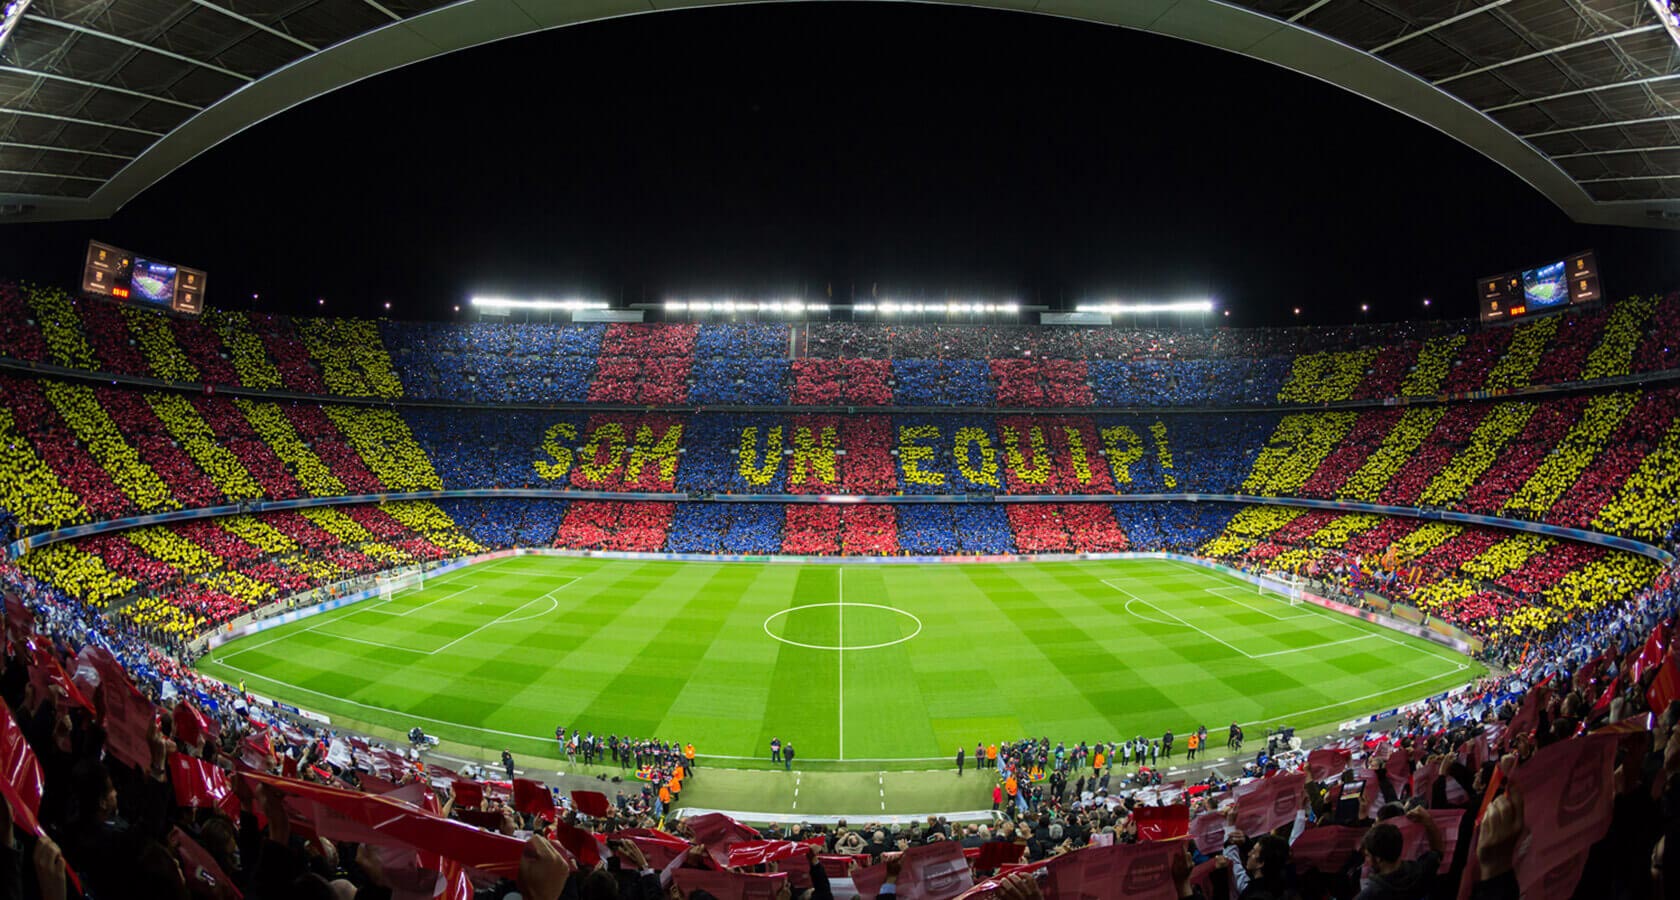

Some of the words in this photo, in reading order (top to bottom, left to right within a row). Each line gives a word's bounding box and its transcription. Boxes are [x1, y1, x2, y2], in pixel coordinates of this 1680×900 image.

[533, 422, 683, 483] SOM
[737, 425, 838, 485] UN
[898, 421, 1177, 488] EQUIP!
